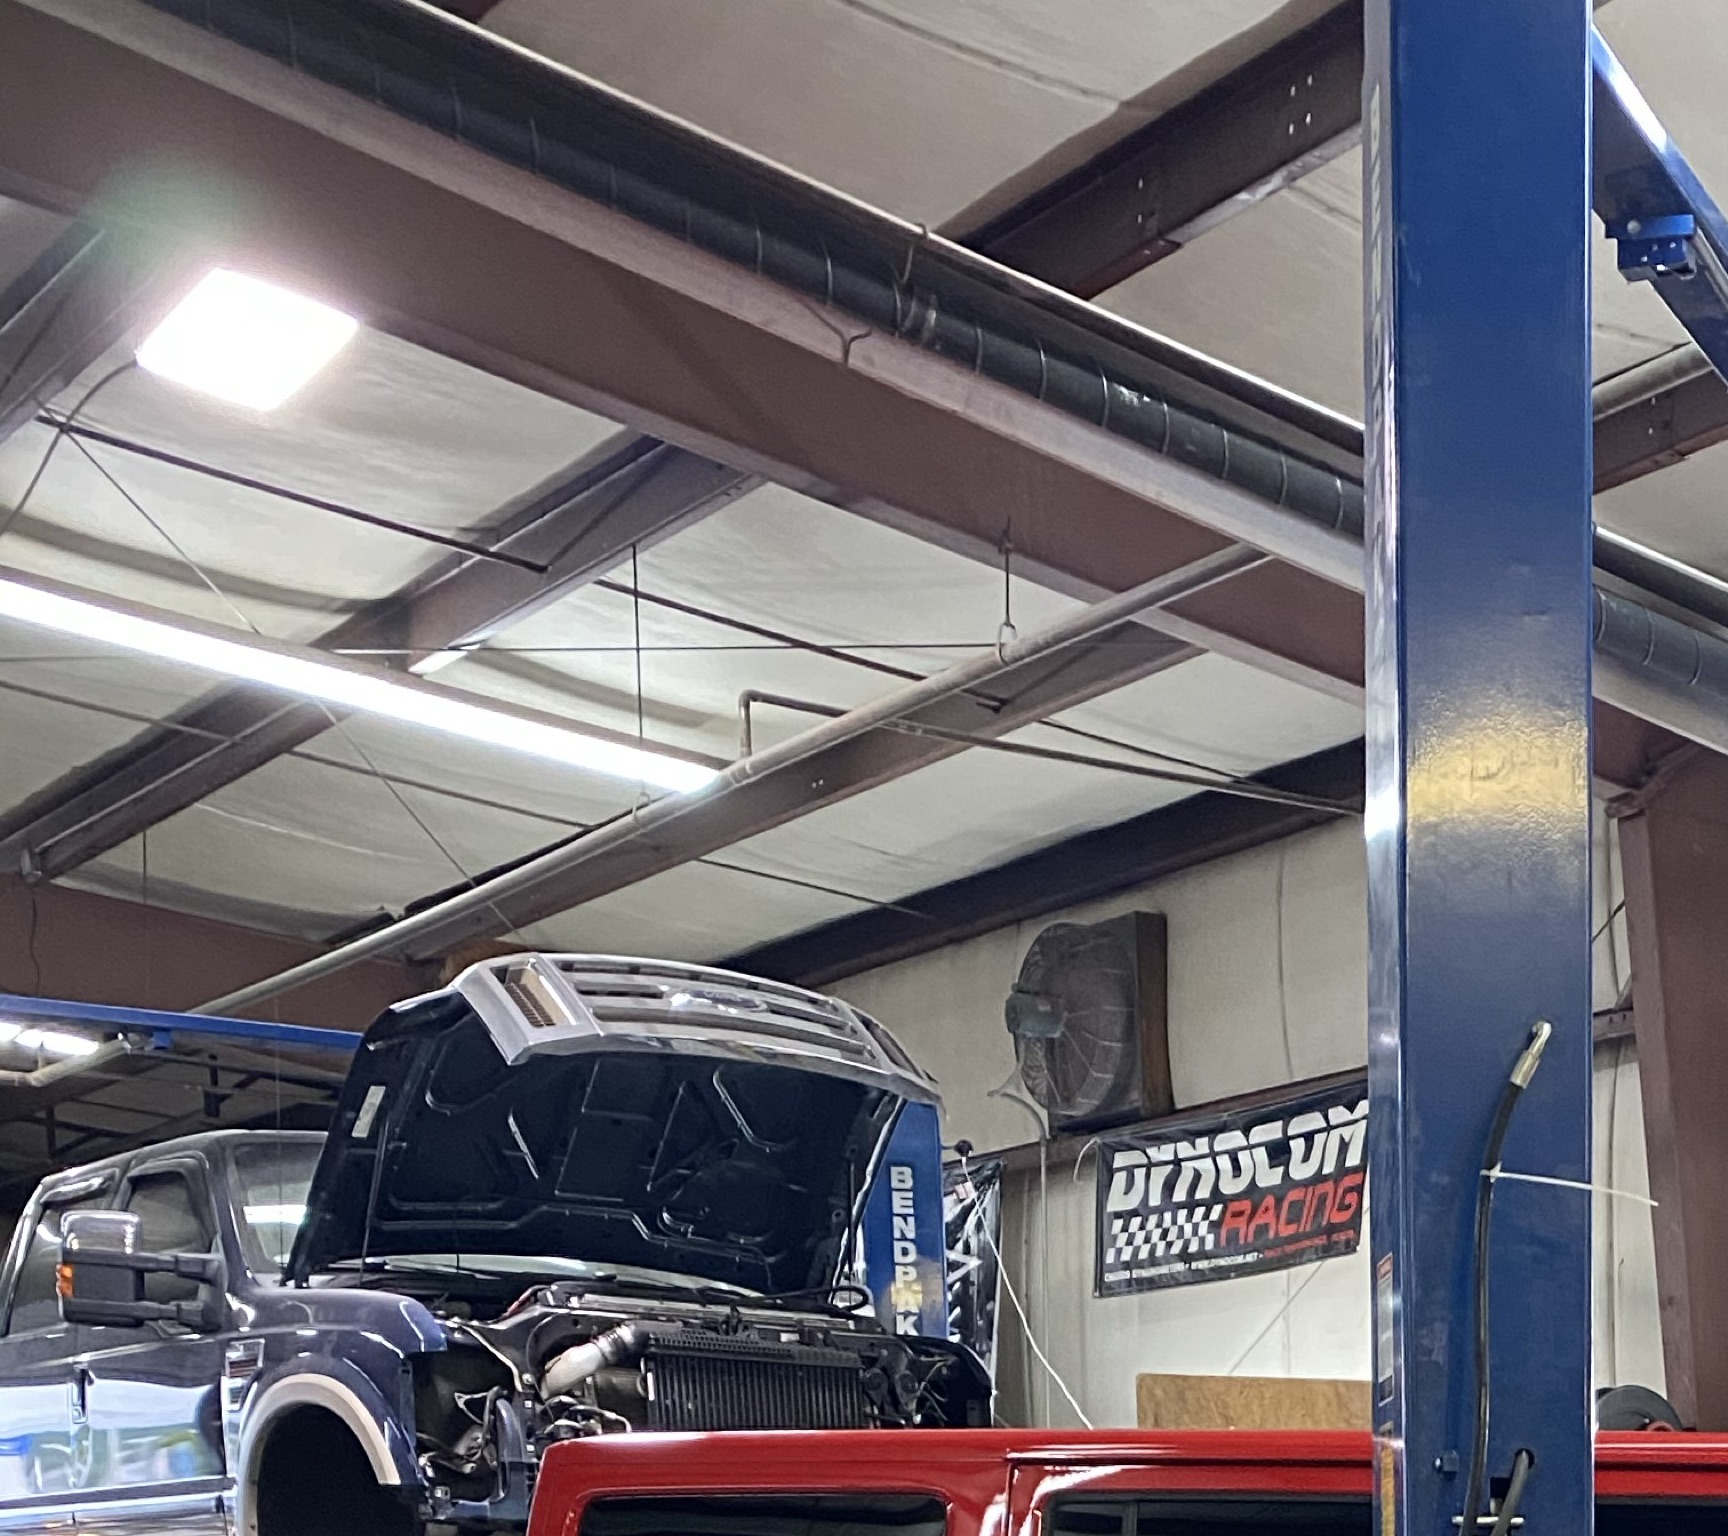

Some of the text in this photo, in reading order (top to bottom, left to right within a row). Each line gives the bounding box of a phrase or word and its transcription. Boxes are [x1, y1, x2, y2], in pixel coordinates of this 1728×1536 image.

[1106, 1099, 1369, 1212] DYNOCOM
[1219, 1171, 1366, 1248] RACING
[890, 1166, 921, 1336] BENDPK
